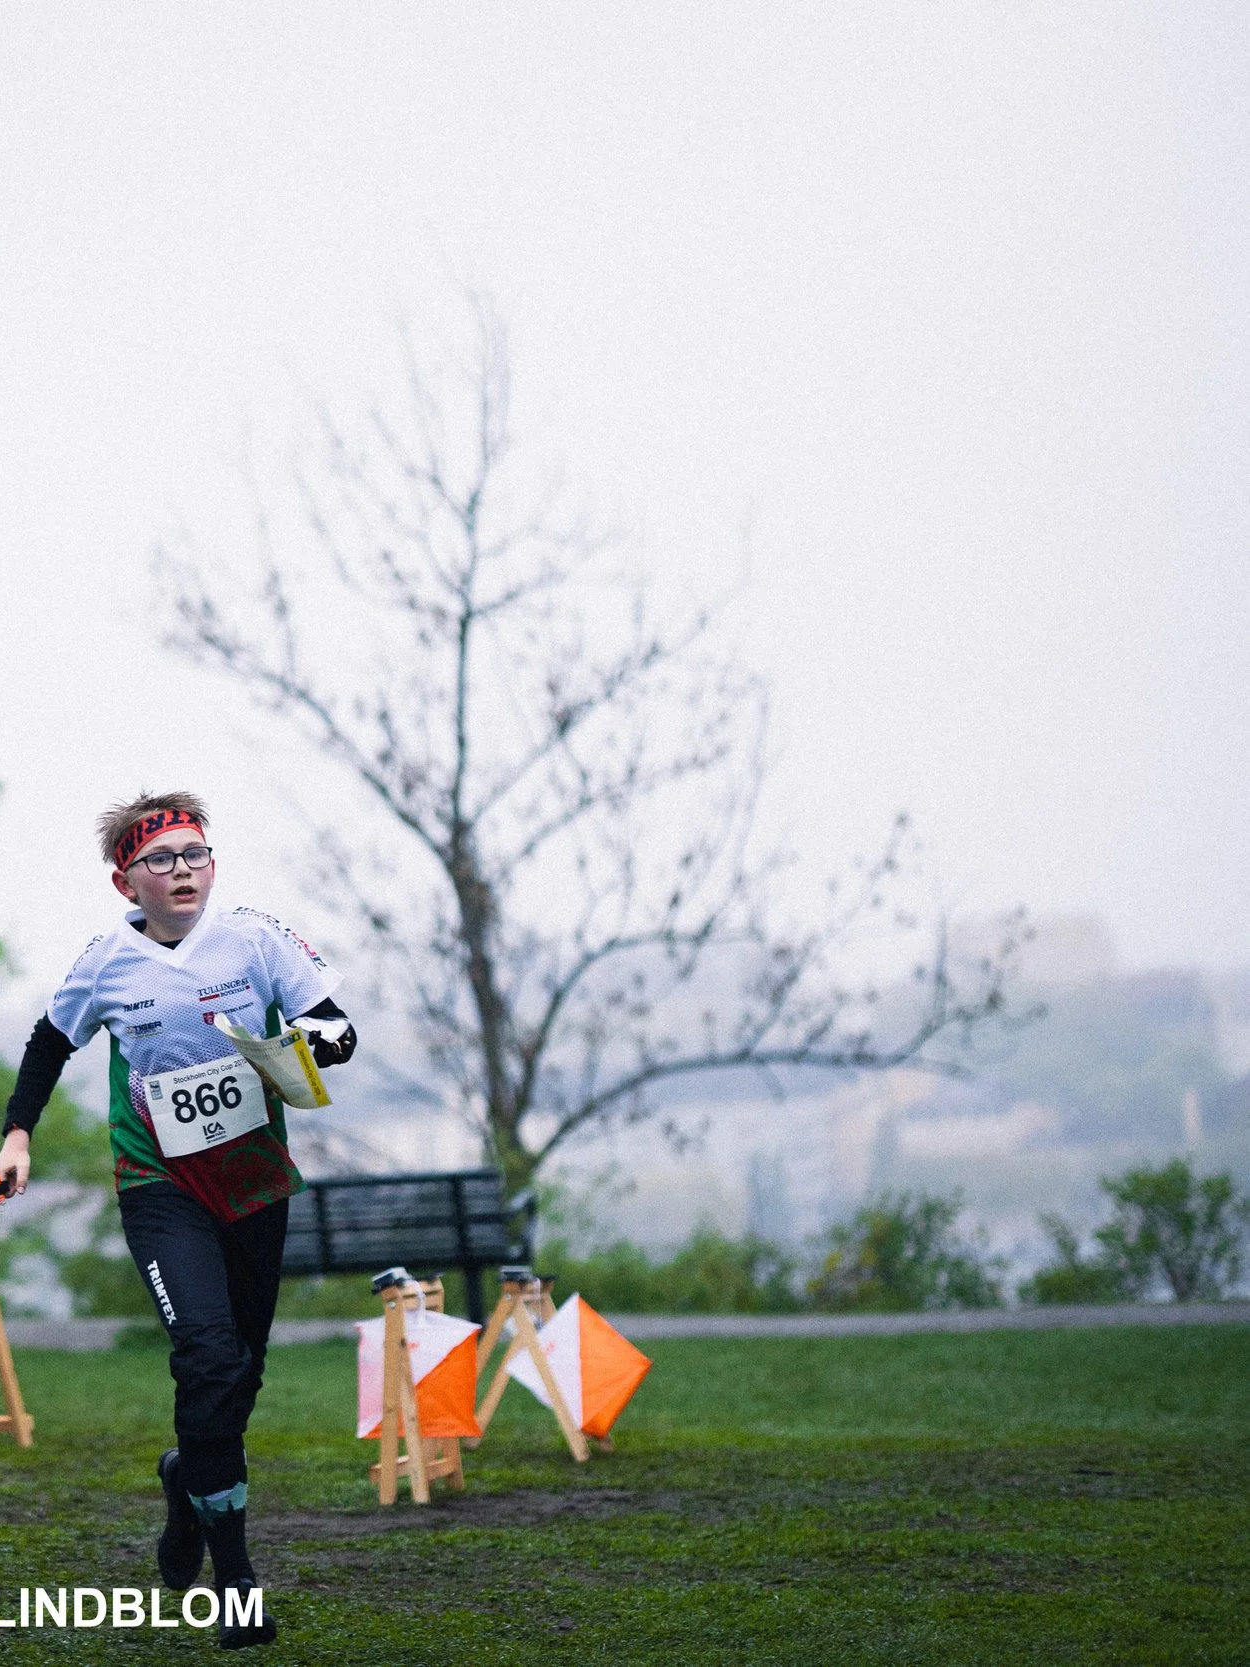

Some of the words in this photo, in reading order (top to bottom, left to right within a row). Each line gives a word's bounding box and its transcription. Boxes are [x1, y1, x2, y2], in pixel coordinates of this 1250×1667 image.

[123, 999, 155, 1012] TRIMTEX
[173, 1070, 206, 1084] Stockholm
[207, 1066, 220, 1076] City
[220, 1063, 234, 1073] Cup
[171, 1075, 242, 1124] 866
[203, 1121, 225, 1136] ICA
[147, 1260, 177, 1325] TRIMTEX
